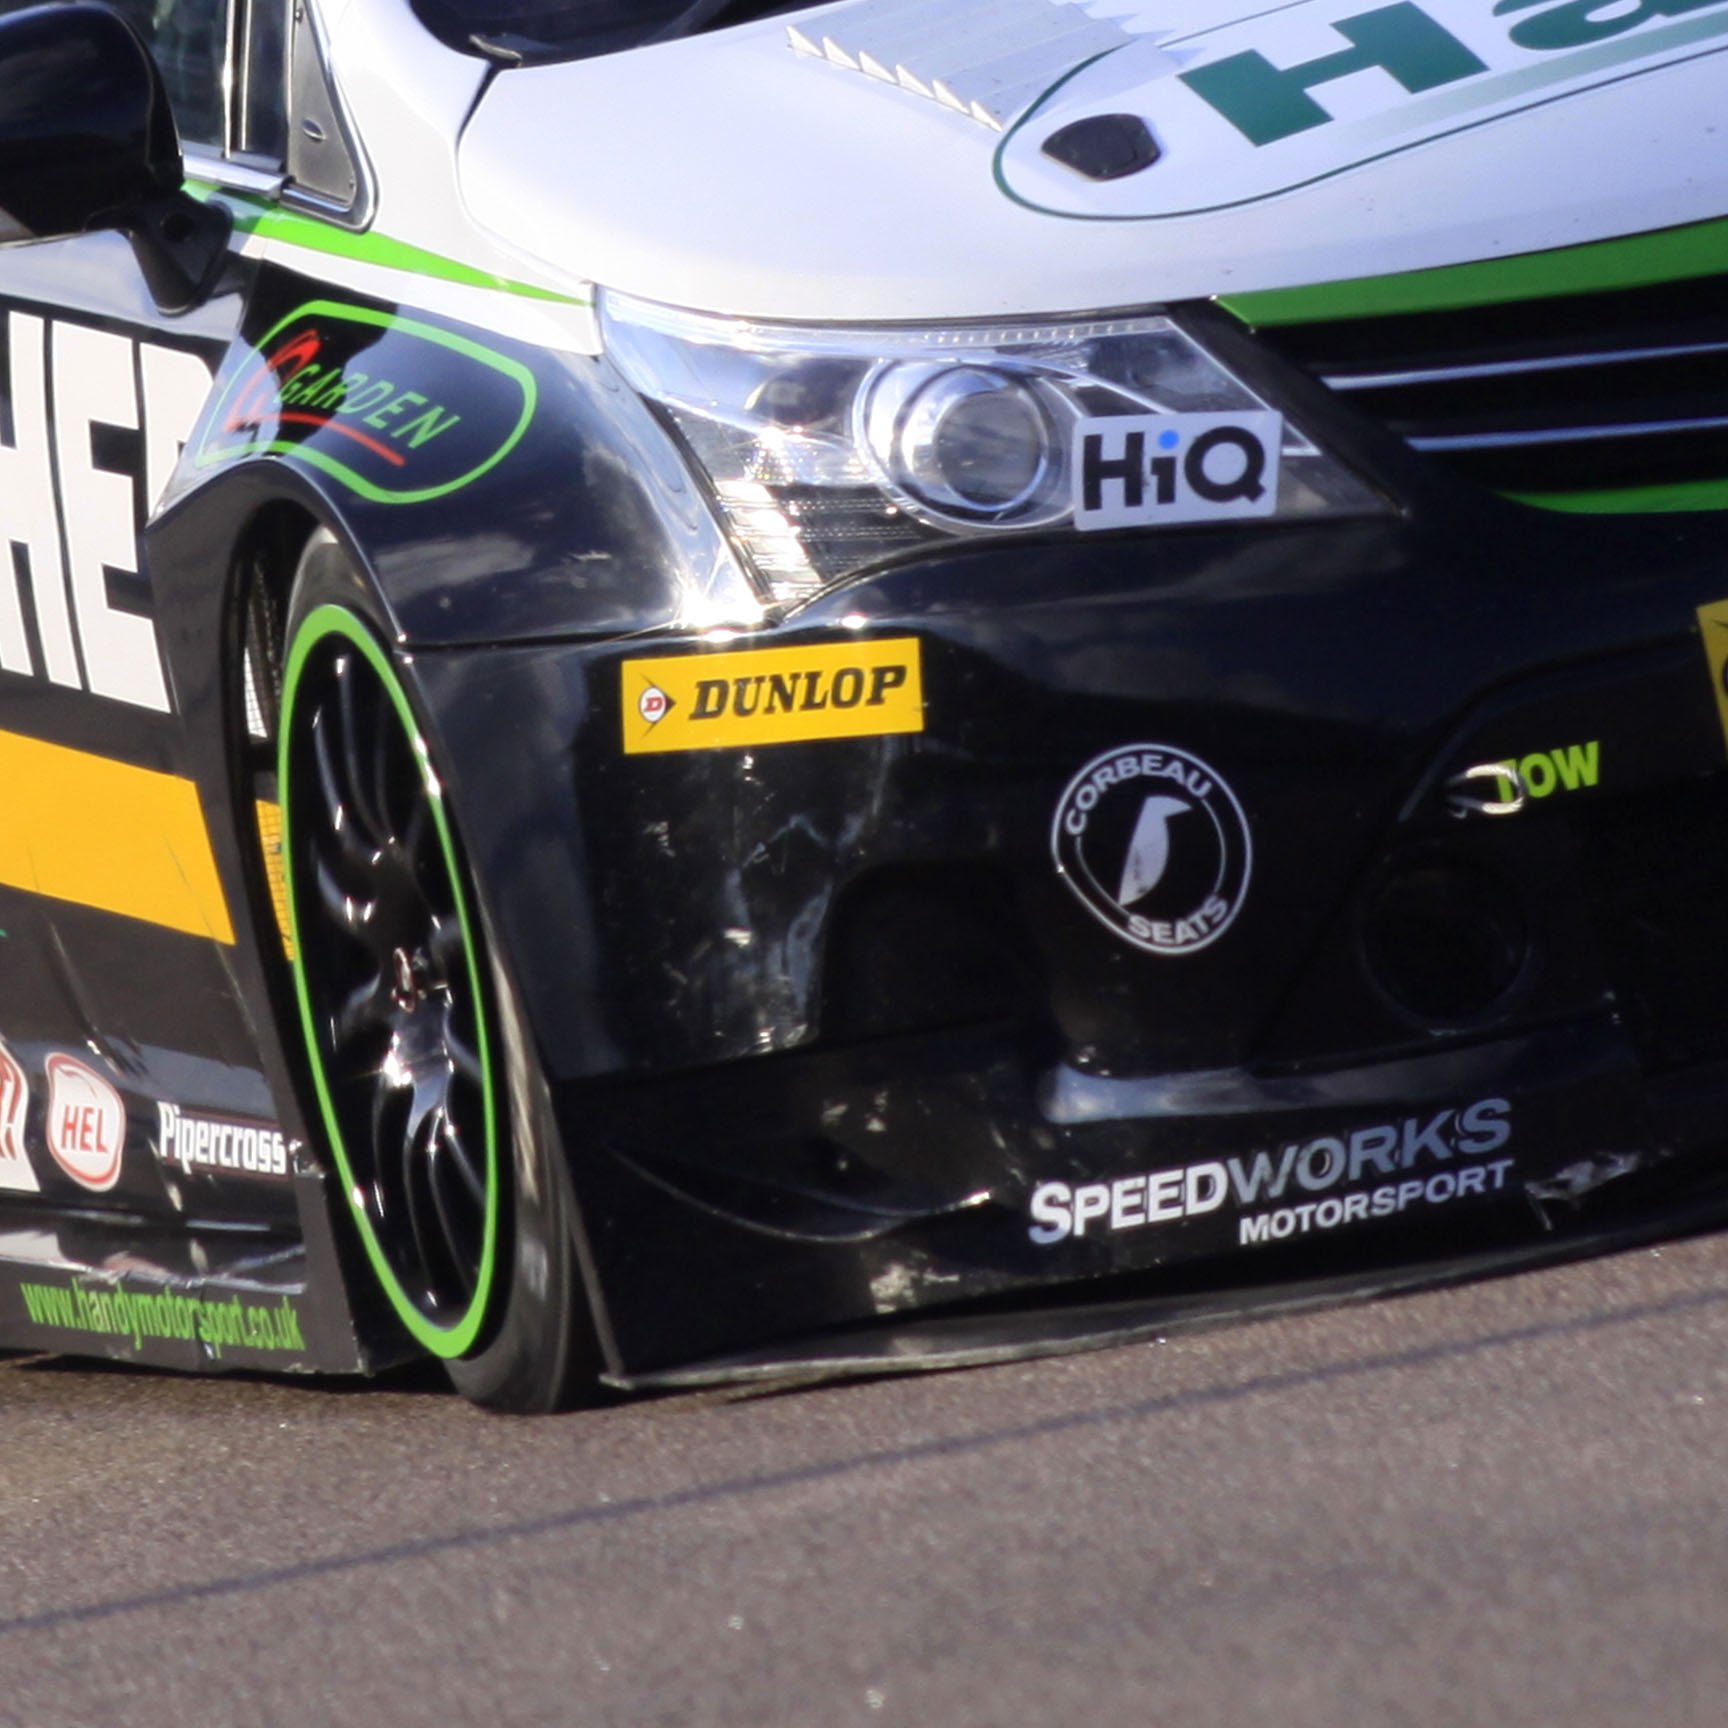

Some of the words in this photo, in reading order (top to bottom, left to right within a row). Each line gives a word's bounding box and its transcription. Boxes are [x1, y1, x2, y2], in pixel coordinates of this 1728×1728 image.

[1080, 422, 1269, 512] HiQ
[688, 664, 908, 721] DUNLOP
[1065, 753, 1213, 836] CORBEAU
[1127, 895, 1229, 944] SEATS
[60, 1105, 109, 1154] HEL
[157, 1101, 288, 1176] Pipercross
[1027, 1097, 1513, 1246] SPEEDWORKS
[1238, 1158, 1515, 1246] MOTORSPORT
